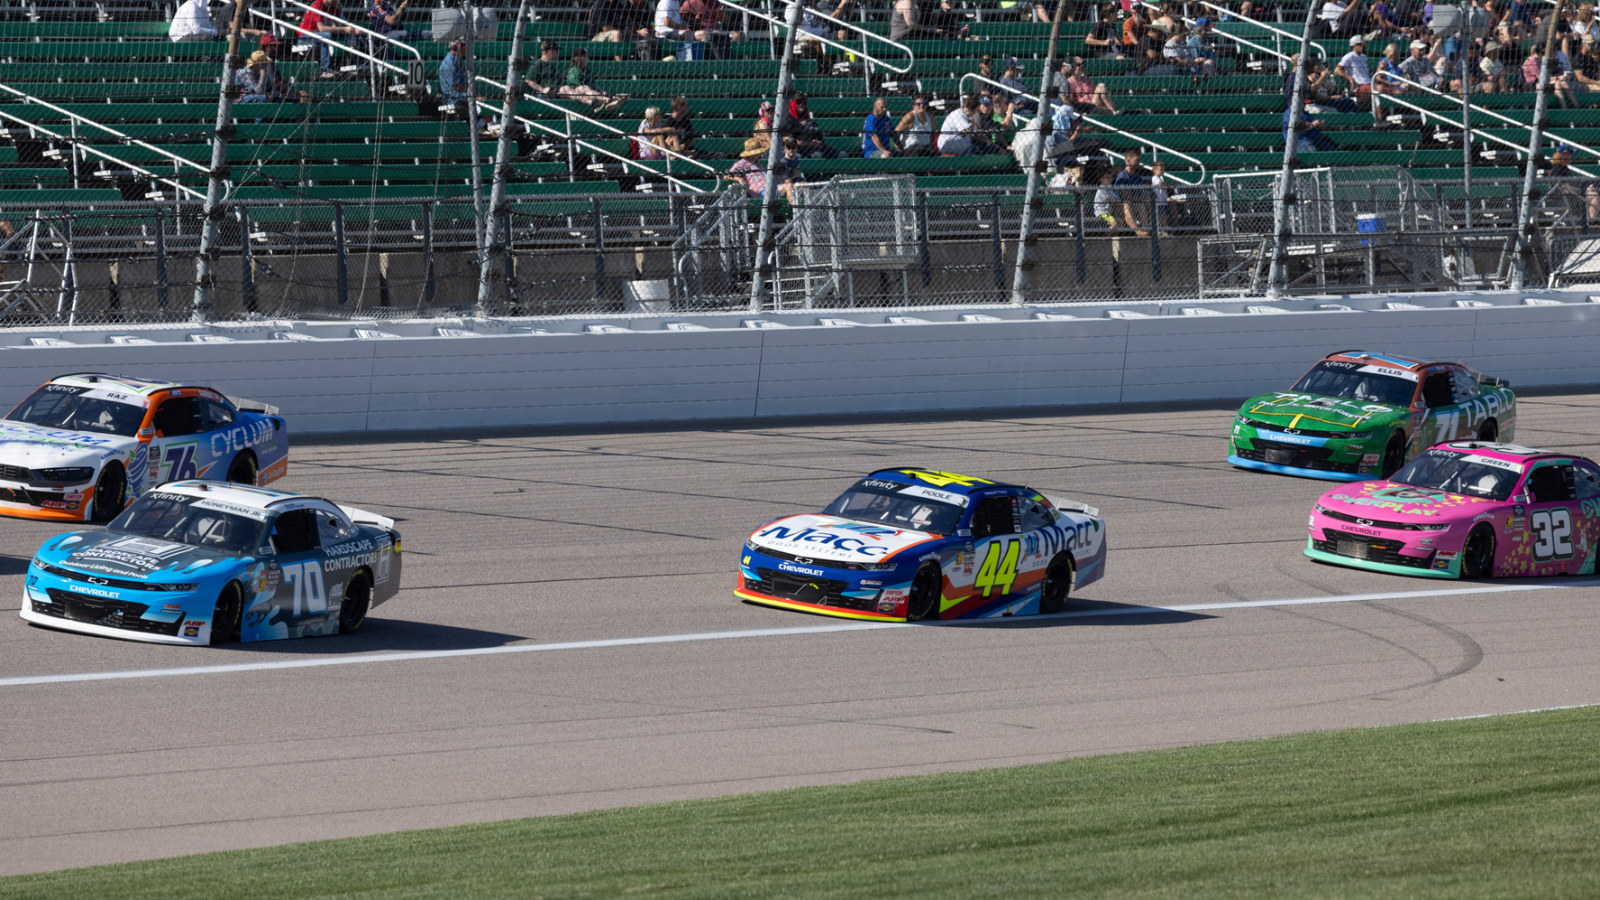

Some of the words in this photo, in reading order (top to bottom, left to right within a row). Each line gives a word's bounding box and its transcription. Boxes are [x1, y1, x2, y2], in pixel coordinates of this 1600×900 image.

[410, 62, 423, 85] 10
[1324, 361, 1356, 369] xfinity
[1377, 368, 1402, 376] ELLIS
[45, 384, 81, 394] xfinity
[107, 392, 128, 400] RAZ
[1458, 387, 1515, 428] TABLO
[1233, 425, 1240, 434] 71
[1436, 408, 1460, 444] 71
[211, 418, 274, 457] CYCLUM
[1269, 434, 1311, 445] CHEVROLET
[162, 441, 199, 480] 76
[1427, 449, 1459, 459] xfinity
[1481, 458, 1511, 468] GREEN
[862, 479, 898, 490] xfinity
[150, 491, 190, 503] xfinity
[922, 489, 952, 500] POOLE
[42, 500, 66, 508] ARP
[201, 500, 250, 513] HONEYMAN
[1331, 493, 1439, 516] OVERPLAY
[1341, 524, 1382, 537] CHEVROLET
[1531, 508, 1574, 562] 32
[323, 538, 373, 557] HARDSCAPE
[759, 525, 889, 556] Macc
[91, 547, 160, 564] HARDSCAPE
[767, 540, 800, 549] DOOR
[804, 545, 853, 559] SYSTEMS
[72, 551, 162, 571] CONTRACTORS
[324, 552, 377, 572] CONTRACTORS
[742, 555, 751, 565] 44
[58, 559, 90, 569] Outdoor
[90, 563, 112, 573] Living
[113, 568, 128, 576] and
[128, 570, 148, 579] Pools
[778, 563, 824, 577] CHEVROLET
[973, 539, 1020, 600] 44
[28, 575, 38, 586] 70
[69, 584, 121, 599] CHEVROLET
[280, 558, 328, 618] 70
